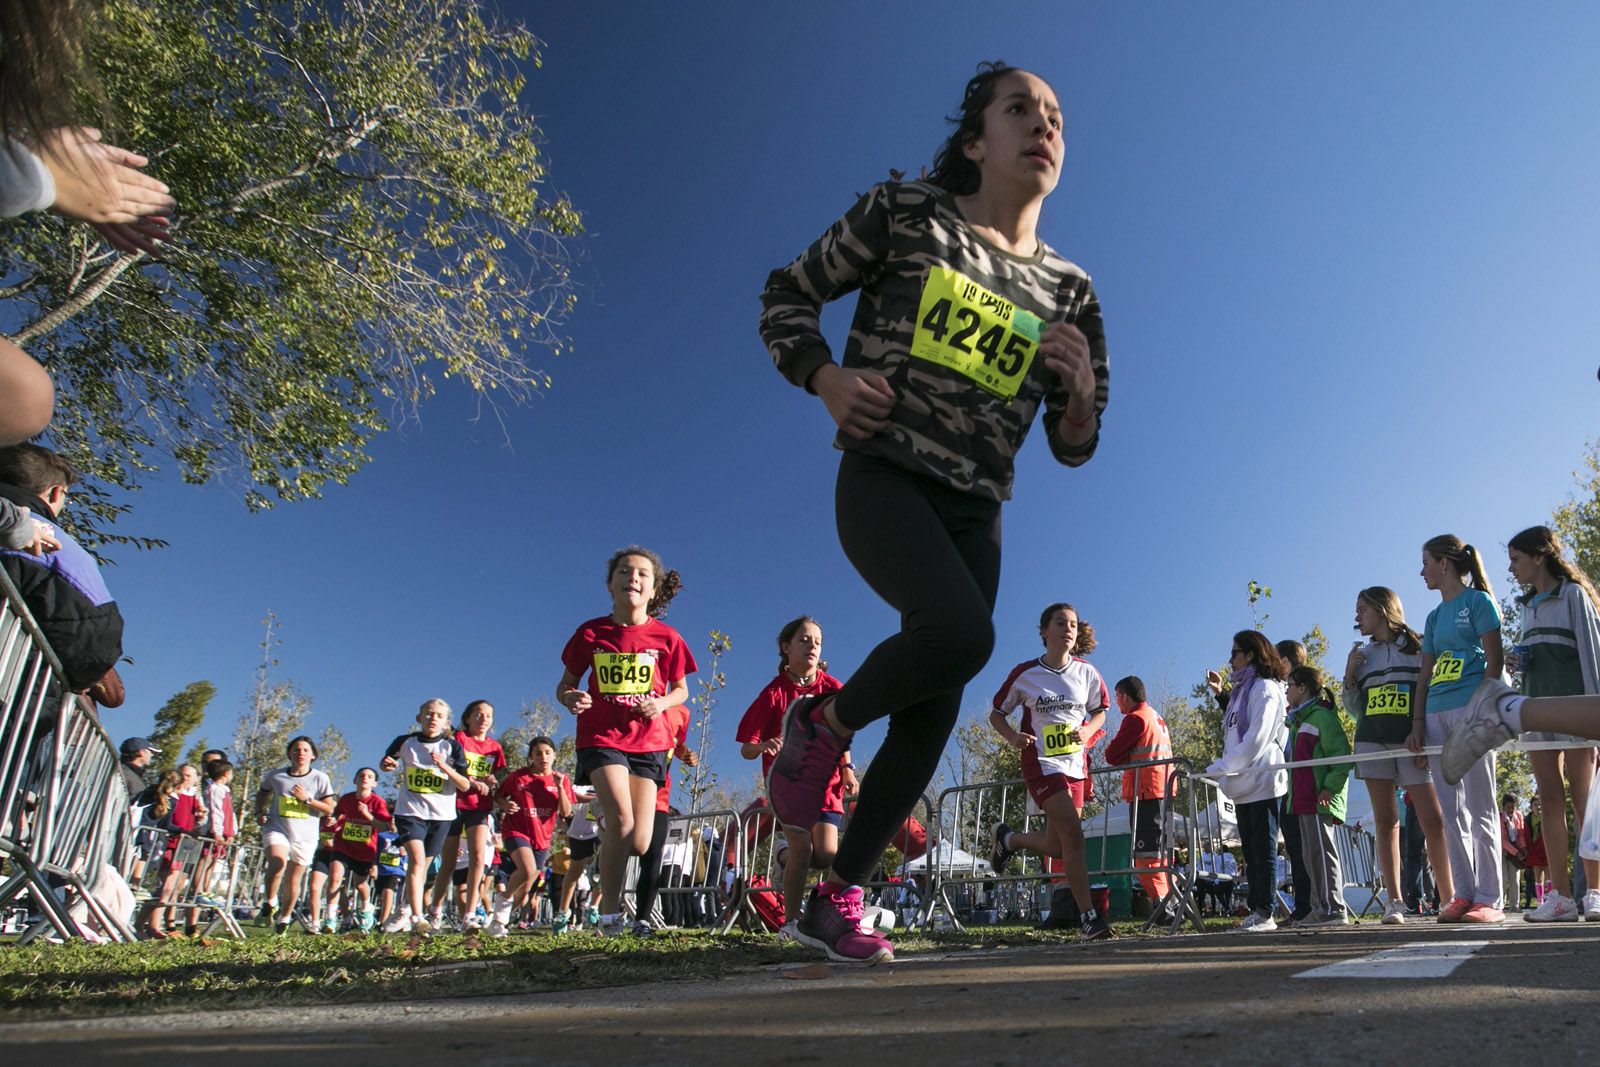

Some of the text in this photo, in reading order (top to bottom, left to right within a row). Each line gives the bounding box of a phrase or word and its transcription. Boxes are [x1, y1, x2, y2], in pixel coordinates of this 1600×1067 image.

[962, 283, 977, 302] 19
[921, 297, 1031, 377] 4245
[599, 665, 651, 684] 0649
[1036, 694, 1065, 706] Agora
[1368, 693, 1407, 709] 3375
[408, 774, 442, 788] 1690
[343, 827, 370, 839] 0653
